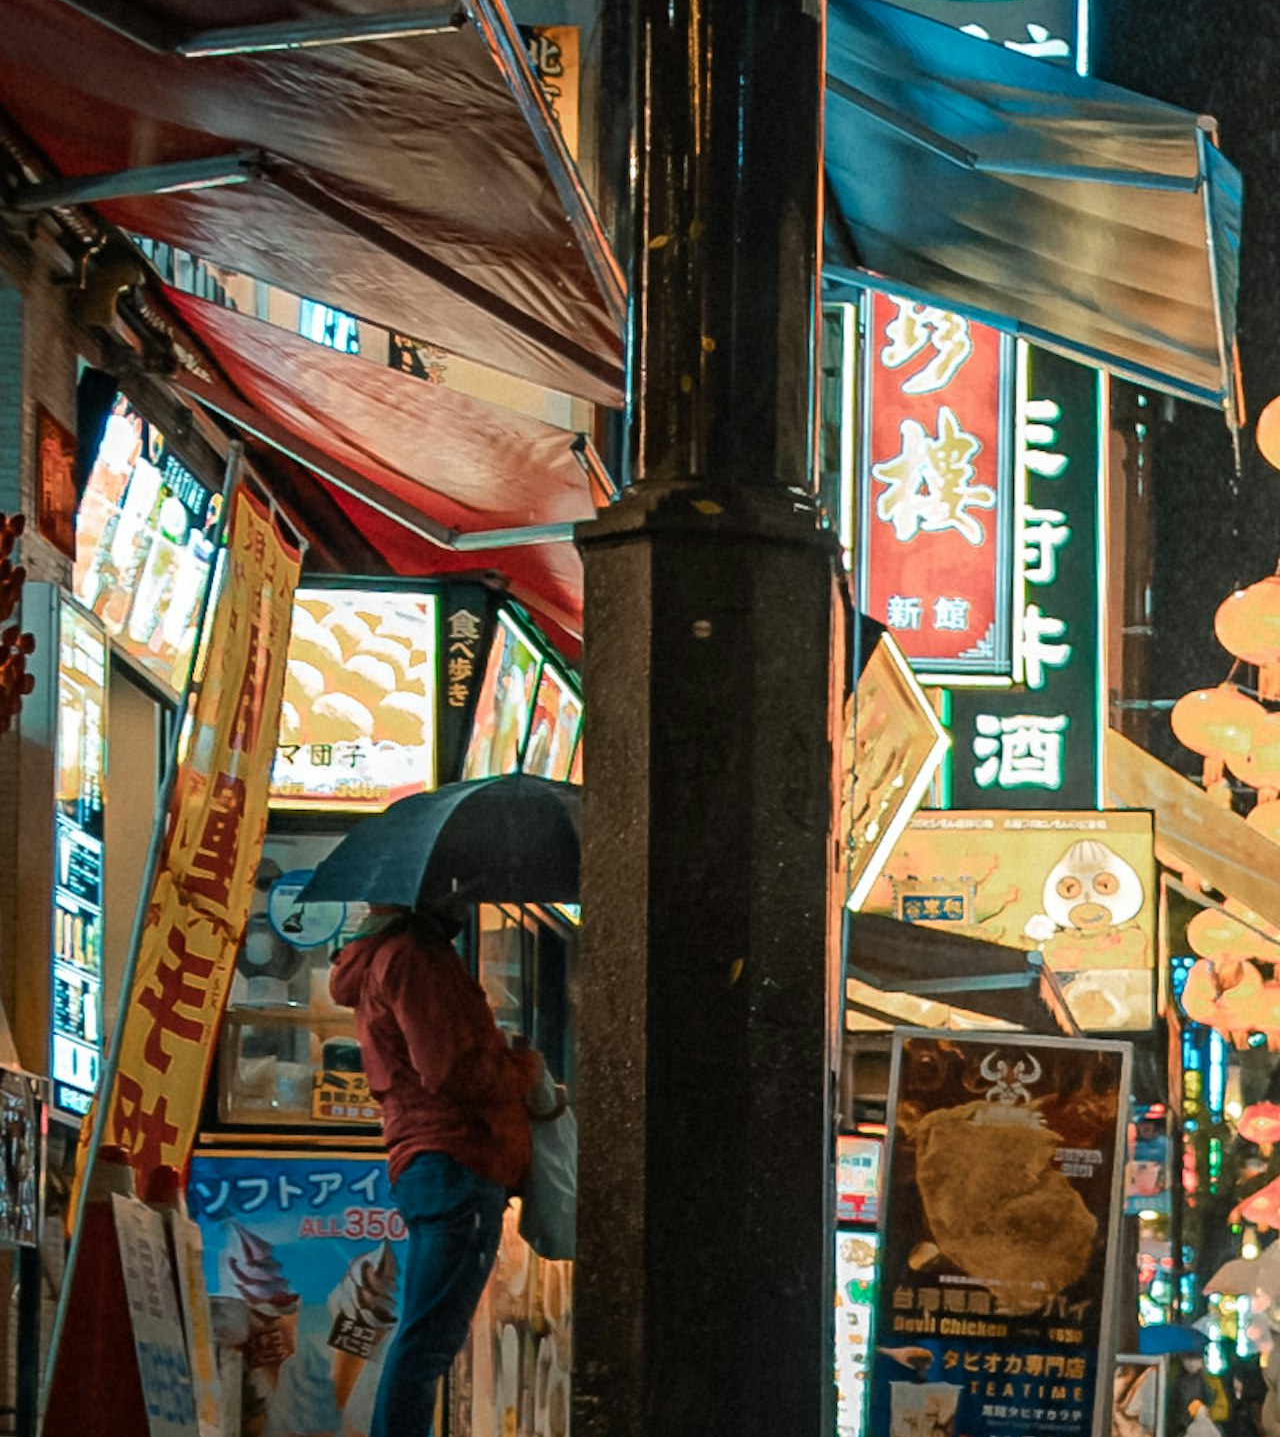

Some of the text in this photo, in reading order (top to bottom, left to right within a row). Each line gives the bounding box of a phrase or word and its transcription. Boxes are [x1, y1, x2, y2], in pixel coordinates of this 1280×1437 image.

[885, 596, 969, 630] 新館
[448, 608, 481, 707] 食べ歩き
